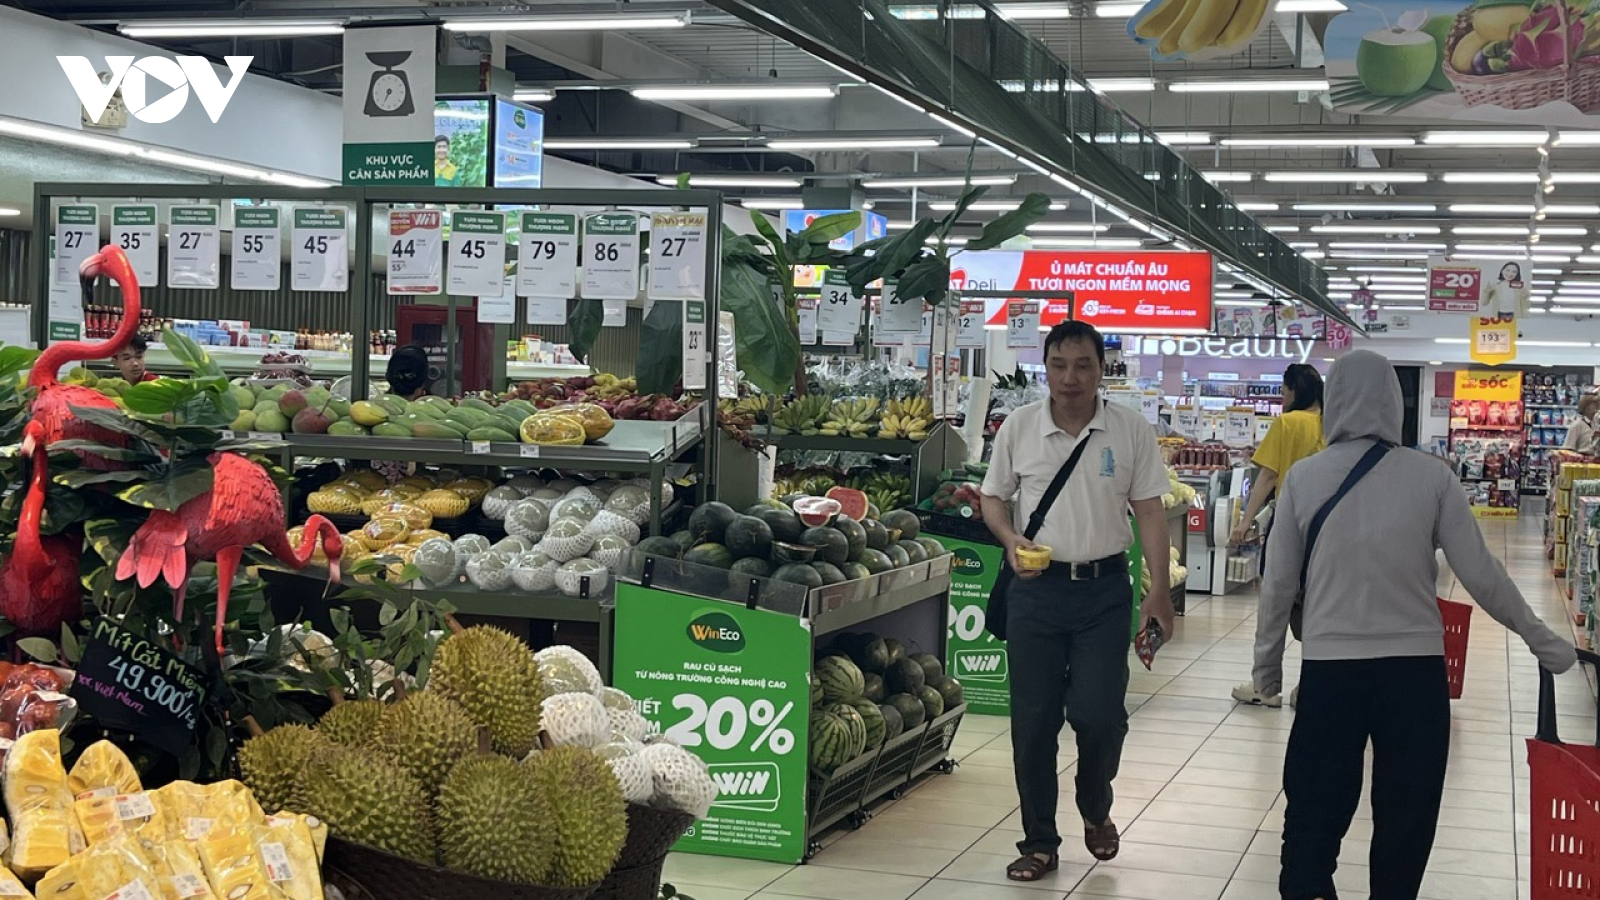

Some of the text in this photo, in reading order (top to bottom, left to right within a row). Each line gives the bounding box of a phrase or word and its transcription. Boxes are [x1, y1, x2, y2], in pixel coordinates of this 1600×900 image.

[366, 154, 414, 167] KHU VỰC
[349, 168, 372, 180] CÂN
[64, 231, 83, 248] 27
[120, 232, 140, 250] 35
[179, 232, 201, 249] 27
[243, 235, 263, 253] 55
[304, 235, 328, 254] 45
[392, 239, 416, 258] 44
[661, 237, 686, 257] 27
[460, 239, 485, 259] 45
[531, 240, 556, 260] 79
[594, 242, 619, 261] 86
[1050, 260, 1168, 276] Ủ MÁT CHUẨN ÂU
[1030, 276, 1191, 295] TƯƠI NGON MỀM MỌNG
[829, 290, 848, 306] 34
[1011, 317, 1025, 328] 13
[1180, 329, 1317, 364] Beauty
[690, 624, 741, 642] WinEco
[683, 661, 702, 671] RAU
[648, 670, 675, 681] NÔNG
[714, 675, 740, 686] CÔNG
[767, 680, 787, 689] CAO
[664, 693, 796, 756] 20%
